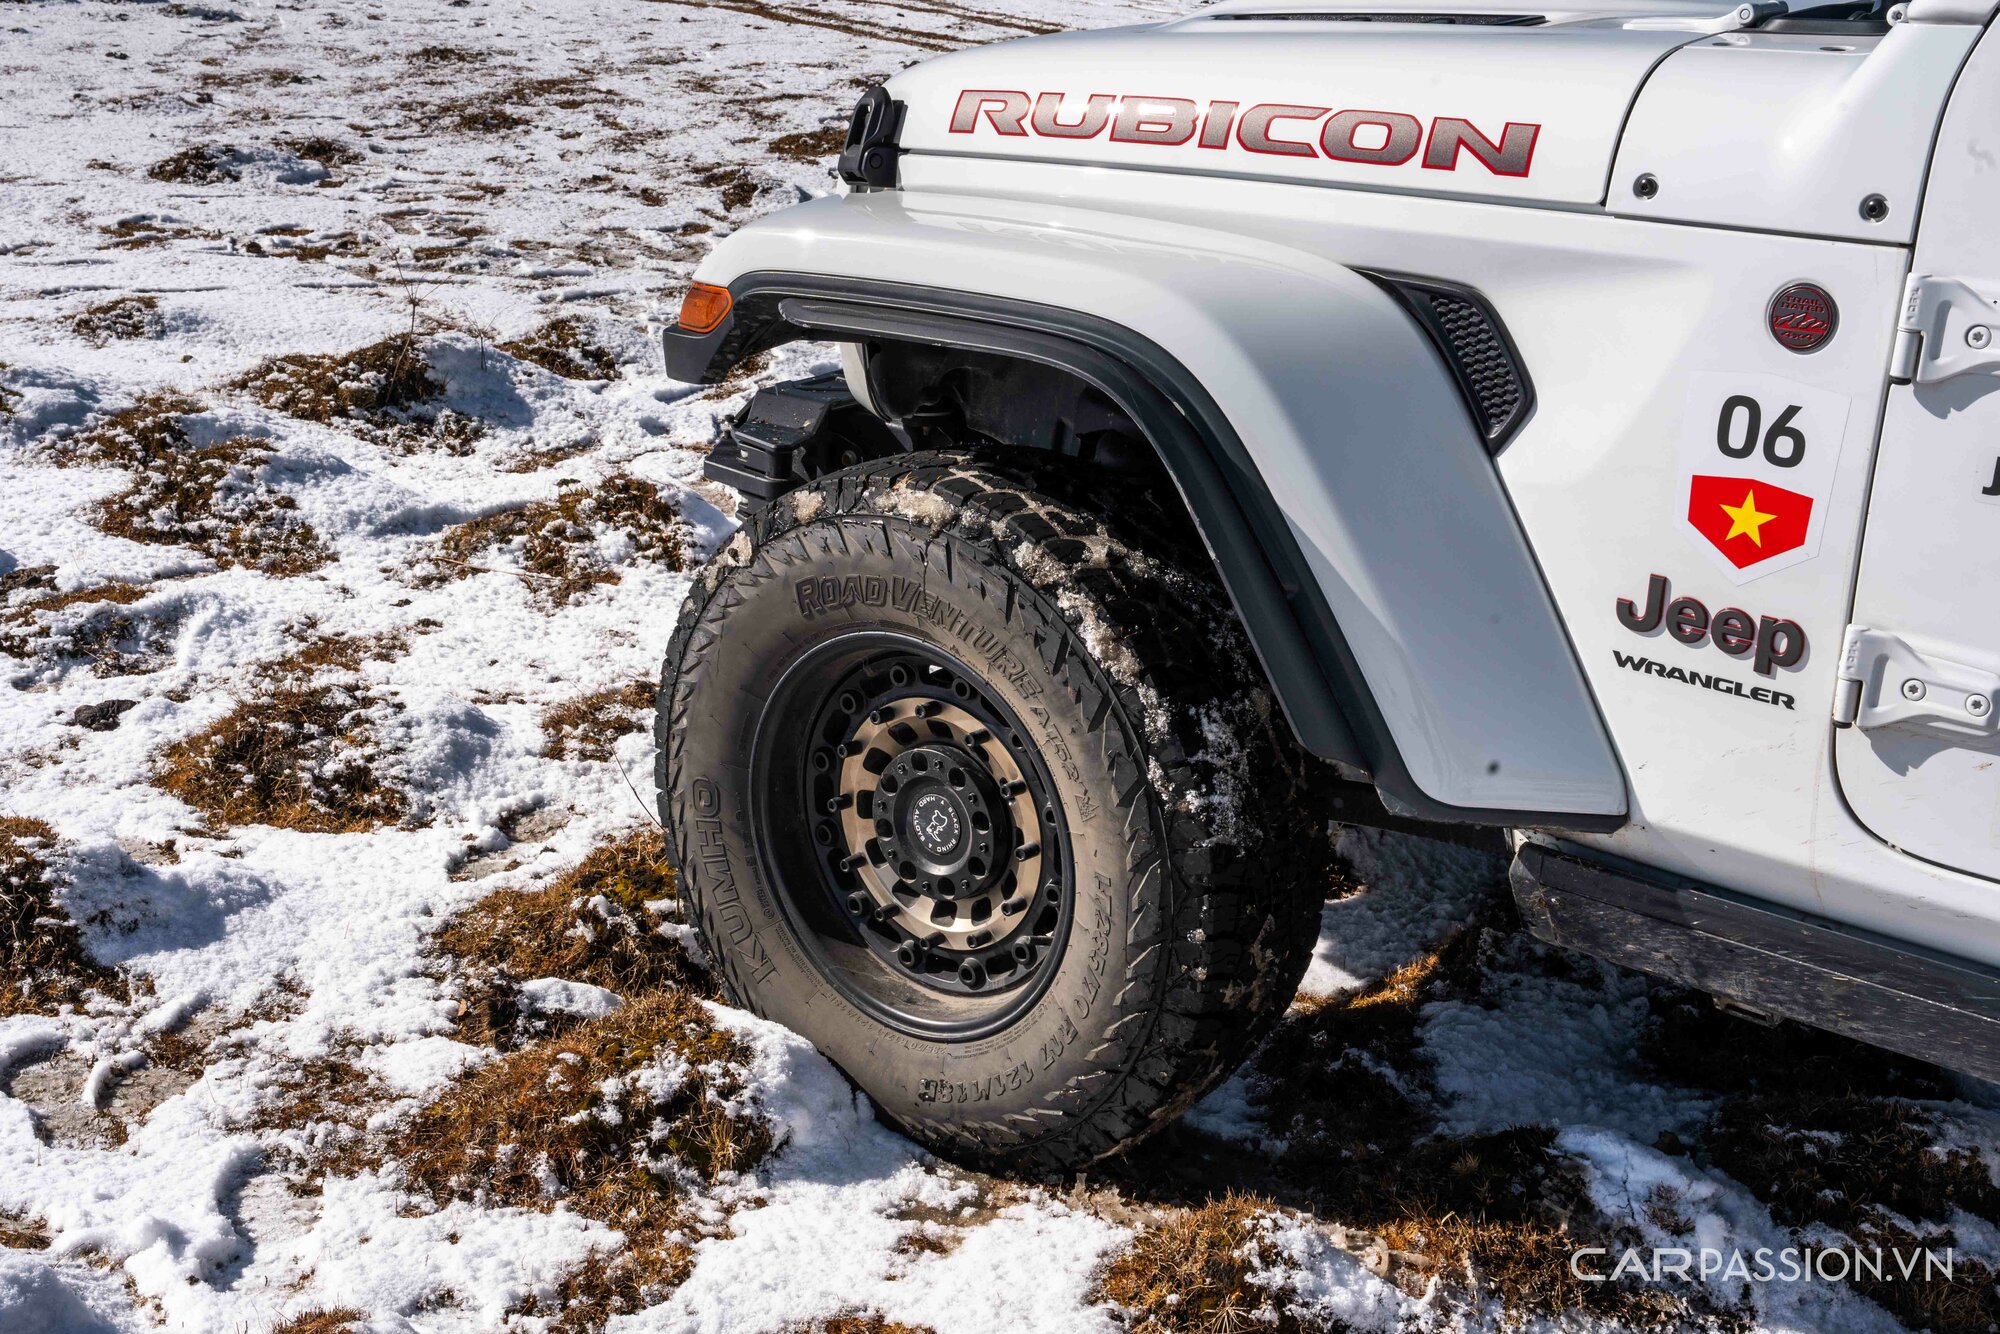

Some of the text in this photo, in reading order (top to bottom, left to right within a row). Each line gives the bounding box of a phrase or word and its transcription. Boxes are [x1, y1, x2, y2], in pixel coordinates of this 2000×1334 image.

[948, 89, 1542, 178] RUBICON
[1716, 395, 1806, 468] 06
[1615, 573, 1808, 675] Jeep
[1612, 650, 1795, 711] WRANGLER
[914, 808, 926, 842] ALLOYS
[936, 807, 959, 853] BLACK RHINO
[692, 776, 777, 985] KUMHO
